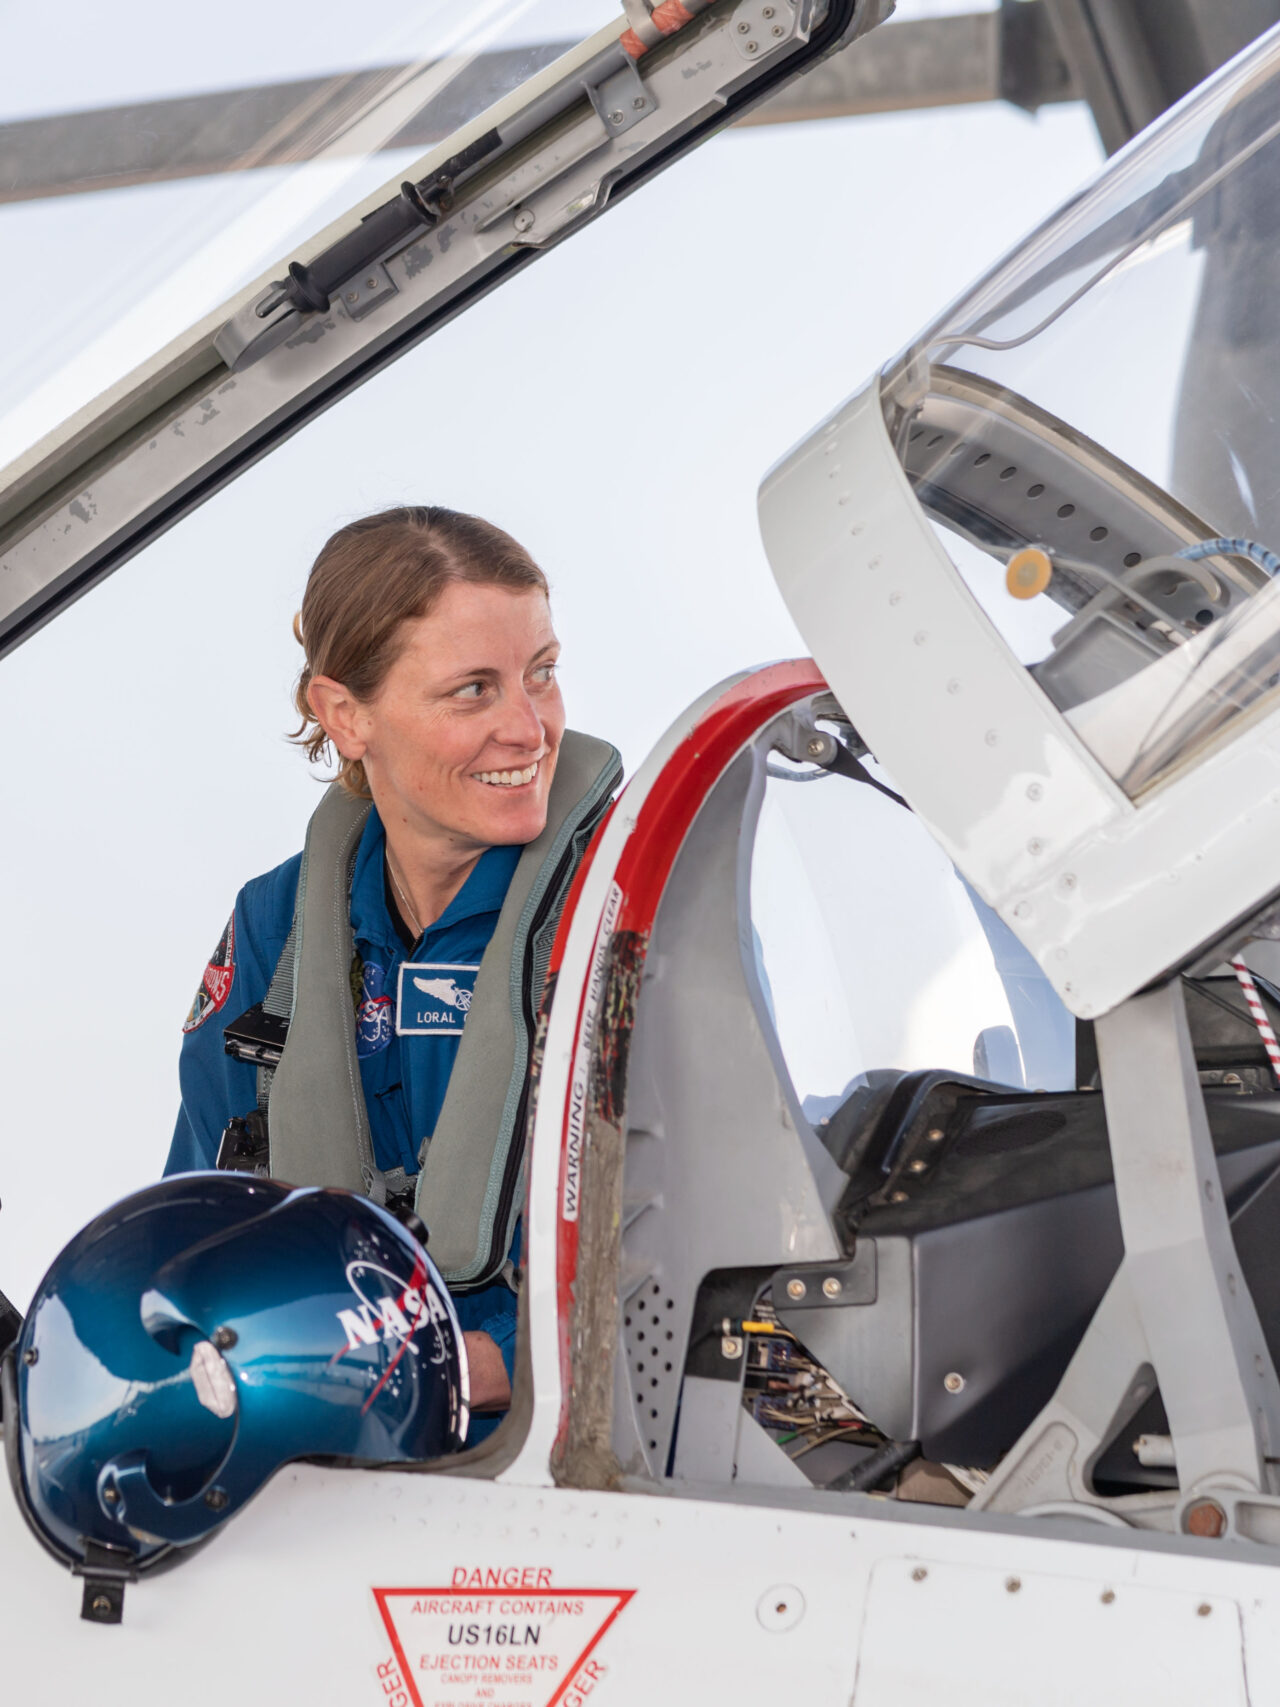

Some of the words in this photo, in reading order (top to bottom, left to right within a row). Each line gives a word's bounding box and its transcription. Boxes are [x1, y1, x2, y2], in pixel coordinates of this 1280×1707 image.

[417, 1011, 456, 1024] LORAL
[566, 1082, 584, 1213] WARNING
[603, 887, 620, 936] CLEAR
[336, 1283, 449, 1350] NASA
[451, 1566, 553, 1589] DANGER
[411, 1600, 495, 1615] AIRCRAFT
[499, 1600, 584, 1616] CONTAINS
[448, 1624, 540, 1646] US16LN
[420, 1655, 500, 1671] EJECTION
[505, 1655, 558, 1671] SEATS
[475, 1687, 495, 1698] AND
